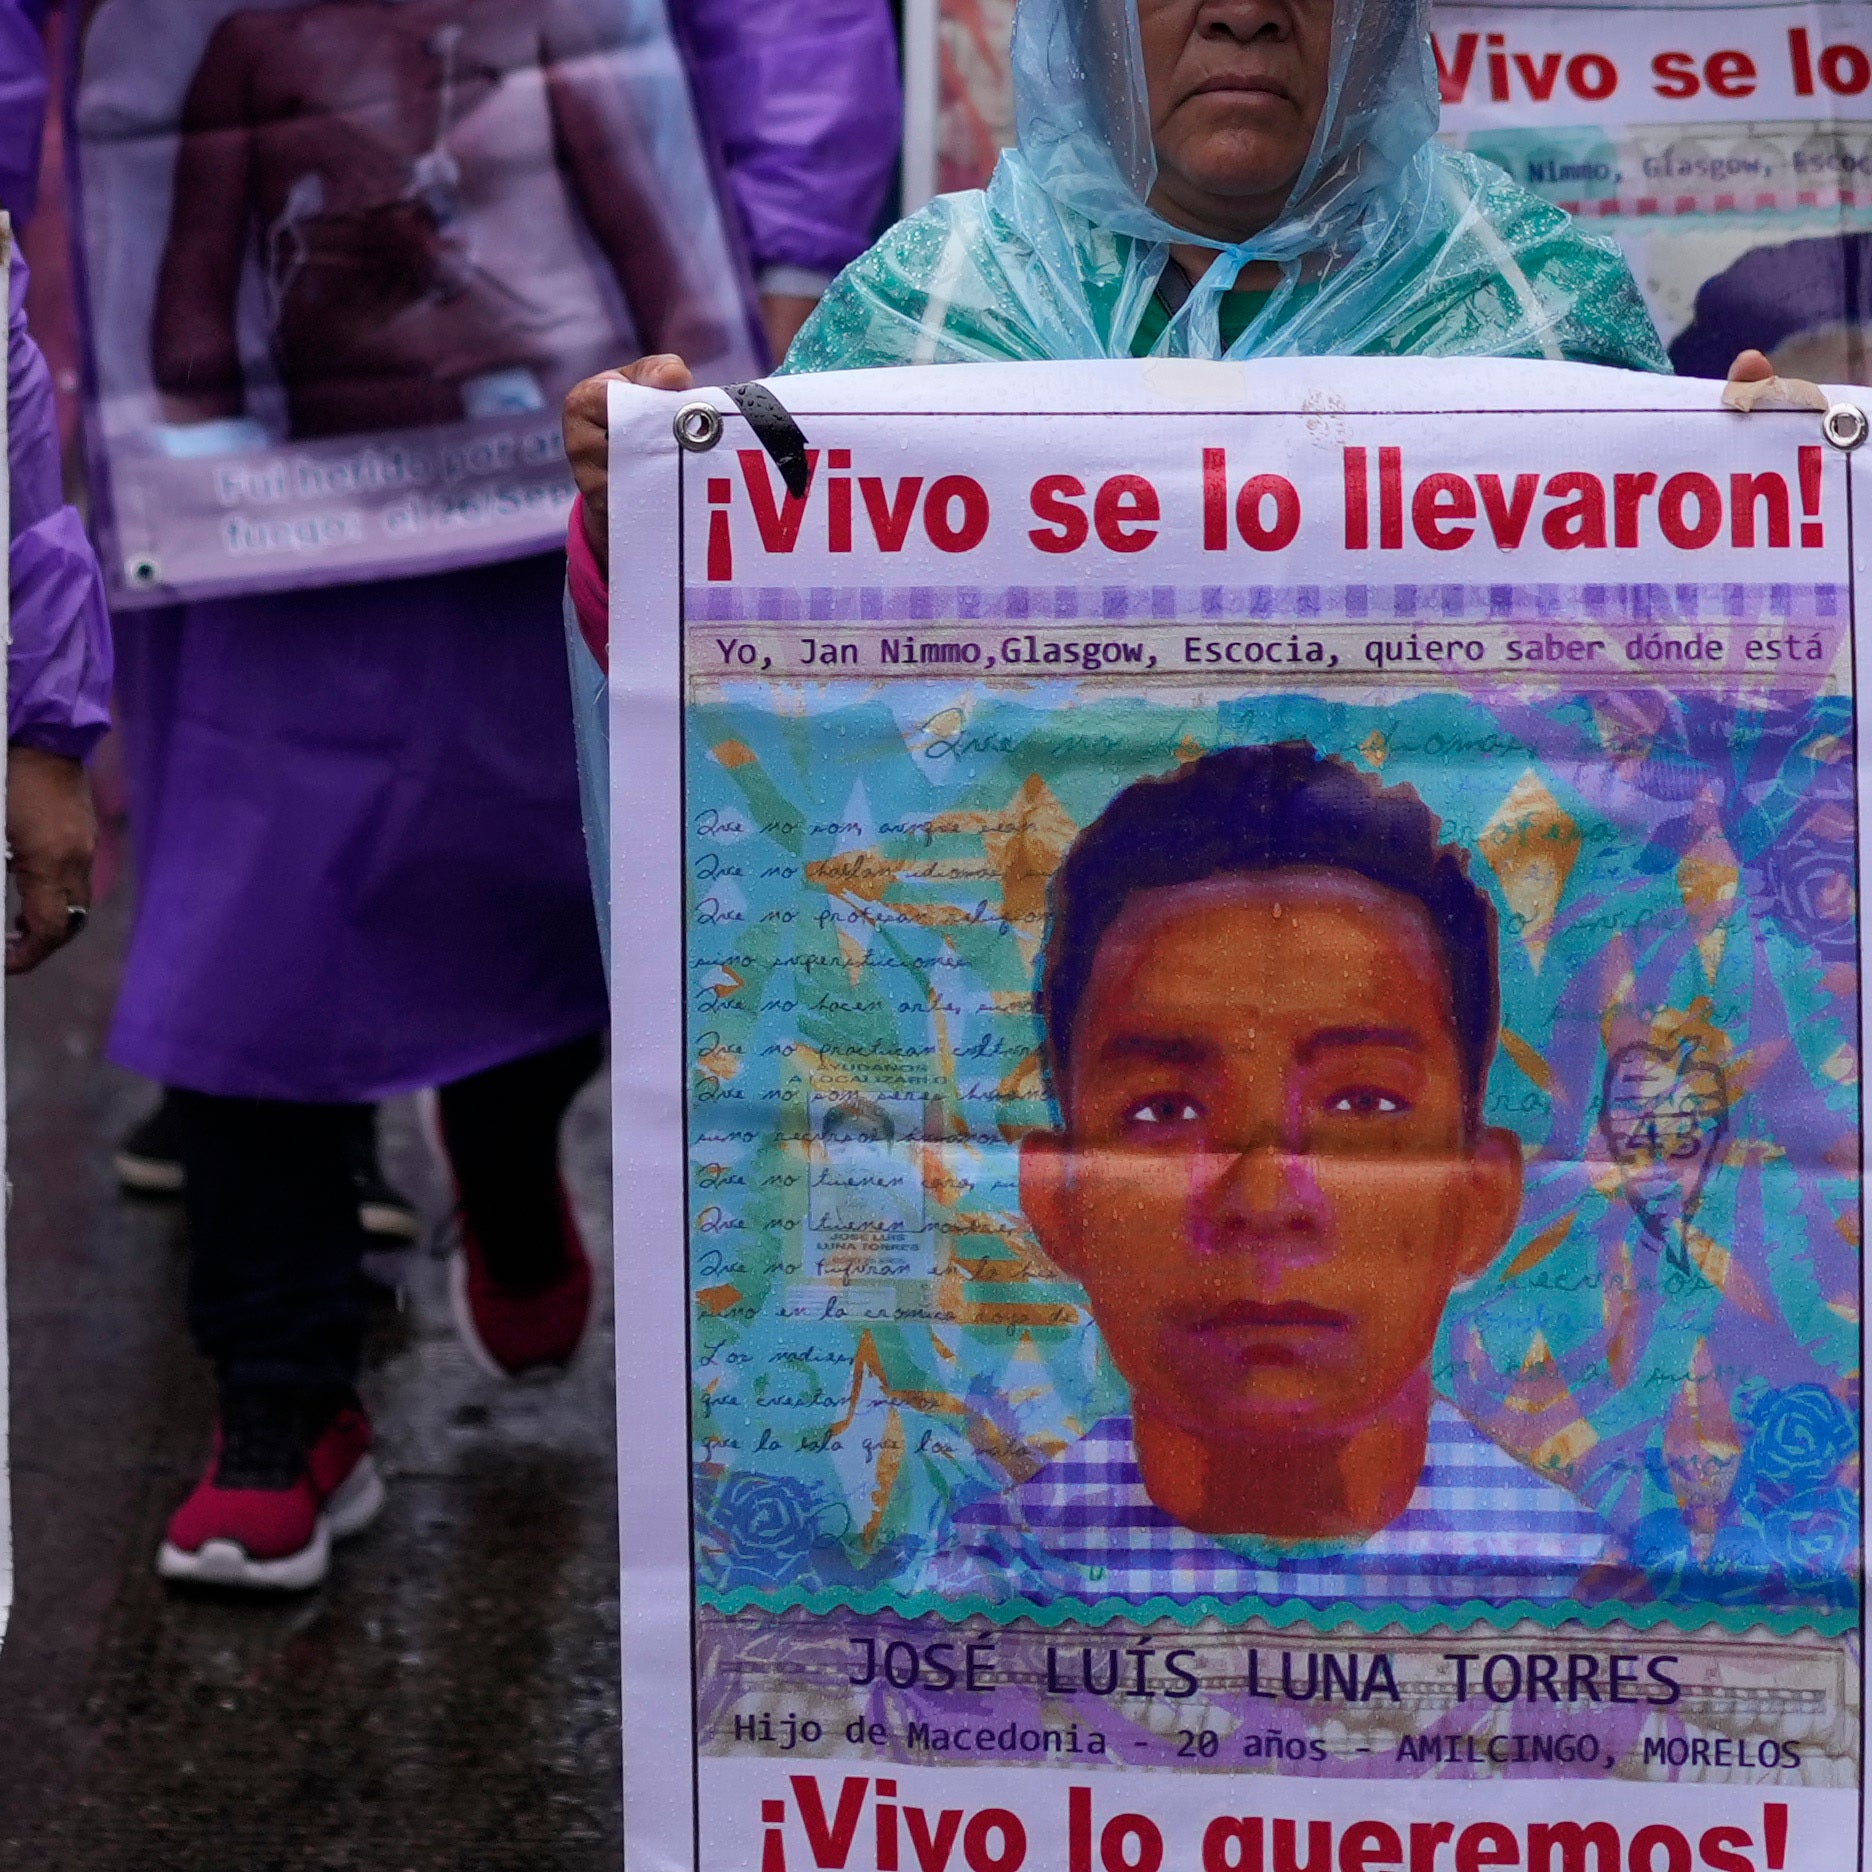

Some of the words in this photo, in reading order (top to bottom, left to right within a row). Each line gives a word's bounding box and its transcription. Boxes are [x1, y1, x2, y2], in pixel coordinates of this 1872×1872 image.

[1651, 49, 1756, 99] se
[1787, 26, 1872, 98] lo
[707, 448, 991, 581] ¡Vivo
[1028, 473, 1161, 554] se
[1202, 447, 1302, 553] lo
[1343, 444, 1825, 551] llevaron!
[717, 638, 773, 671] Yo,
[800, 638, 859, 665] Jan
[1183, 636, 1340, 668] Escocia,
[1364, 635, 1485, 668] quiero
[1506, 633, 1605, 662] saber
[1628, 633, 1723, 662] dónde
[1744, 633, 1824, 662] está
[849, 1630, 997, 1692] JOSÉ
[1047, 1636, 1200, 1699] LUÍS
[1247, 1648, 1401, 1702] LUNA
[1445, 1652, 1682, 1705] TORRES
[734, 1713, 822, 1750] Hijo
[845, 1714, 888, 1746] de
[908, 1722, 1107, 1755] Macedonia
[1176, 1729, 1218, 1758] 20
[1243, 1732, 1326, 1761] años
[1396, 1733, 1617, 1770] AMILCINGO,
[1643, 1736, 1802, 1769] MORELOS
[761, 1774, 1027, 1872] ¡Vivo
[1067, 1785, 1164, 1872] lo
[1201, 1801, 1790, 1872] queremos!
